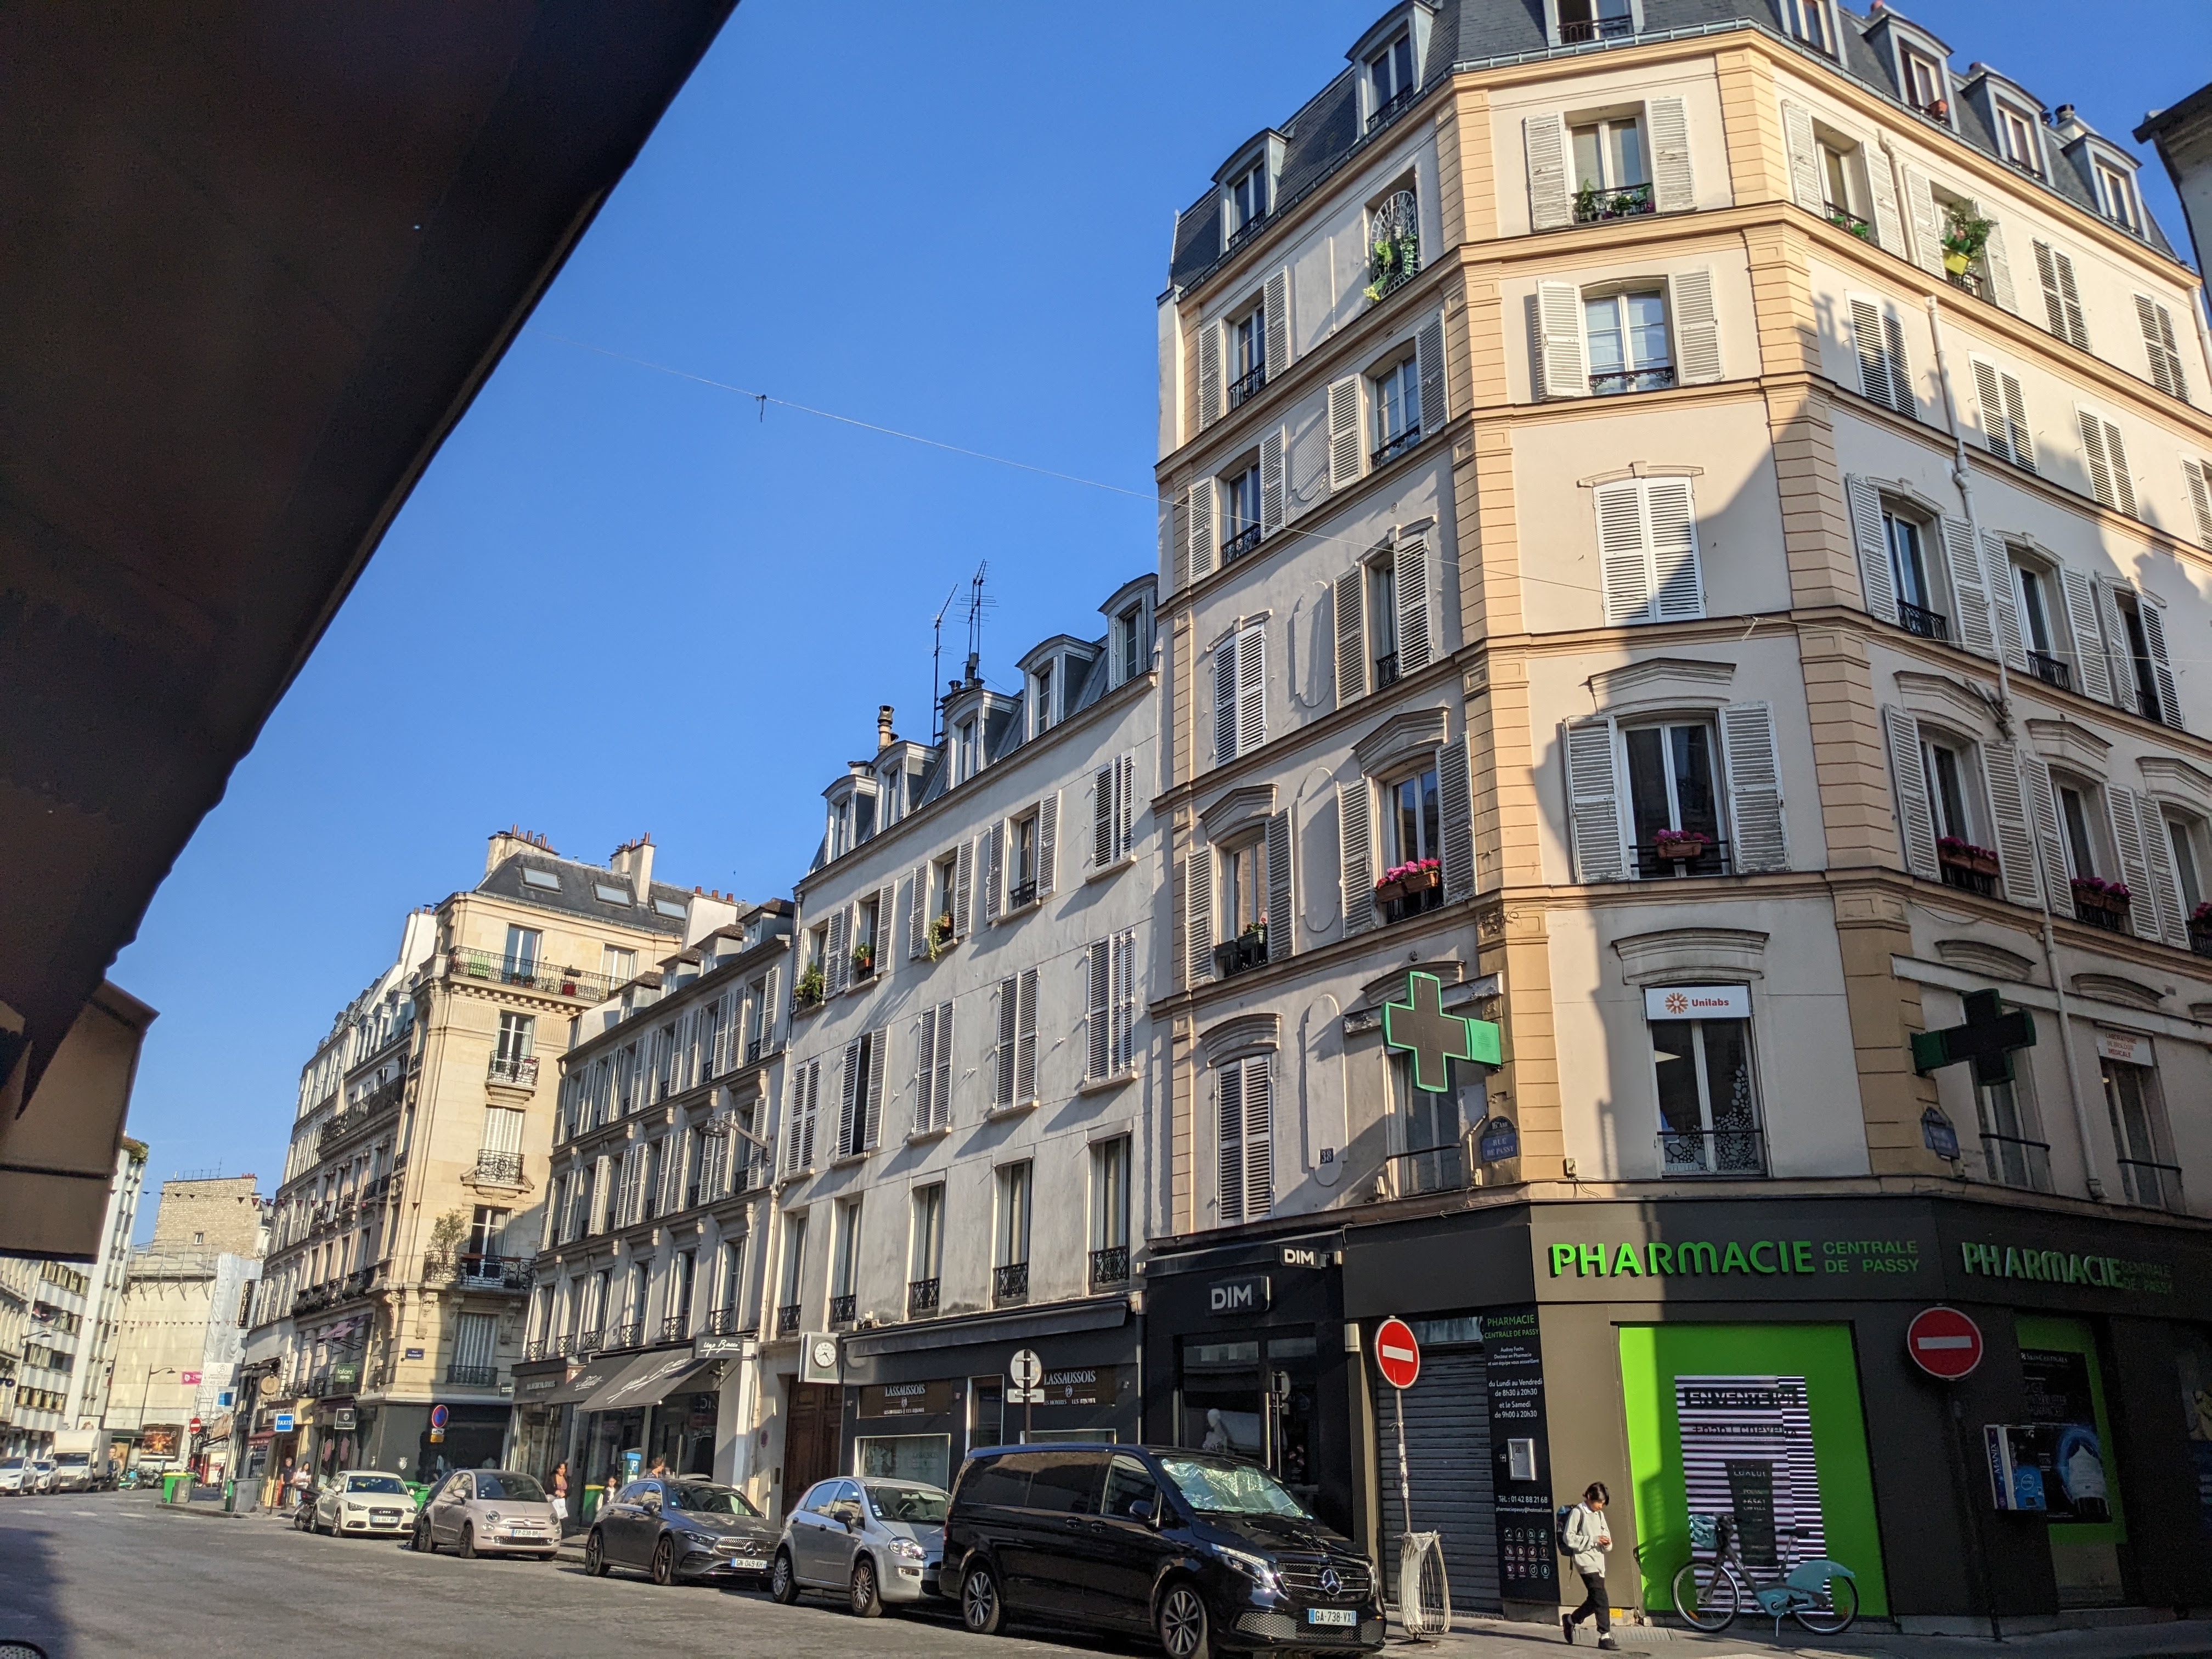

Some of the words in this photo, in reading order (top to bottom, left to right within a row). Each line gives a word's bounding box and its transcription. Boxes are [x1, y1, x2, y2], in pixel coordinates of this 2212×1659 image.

[1691, 998, 1729, 1007] Unilabs
[1284, 1249, 1314, 1265] DIM
[1552, 1240, 1815, 1276] PHARMACIE
[1824, 1240, 1918, 1255] CENTRALE
[1825, 1259, 1849, 1273] DE
[1862, 1258, 1919, 1273] PASSY
[1961, 1242, 2125, 1288] PHARMACIE
[1211, 1284, 1252, 1310] DIM
[1487, 1314, 1535, 1327] PHARMACIE
[1043, 1370, 1096, 1385] LASSAUSSOIS
[1519, 1378, 1543, 1386] Vendredi
[884, 1384, 926, 1397] LASSAUSSOIS
[1521, 1387, 1538, 1396] 20h30
[1520, 1409, 1537, 1418] 20h30
[1990, 1443, 2001, 1474] MANIX
[736, 1559, 763, 1568] GN-049-KH
[1315, 1611, 1351, 1623] GA-738-VX
